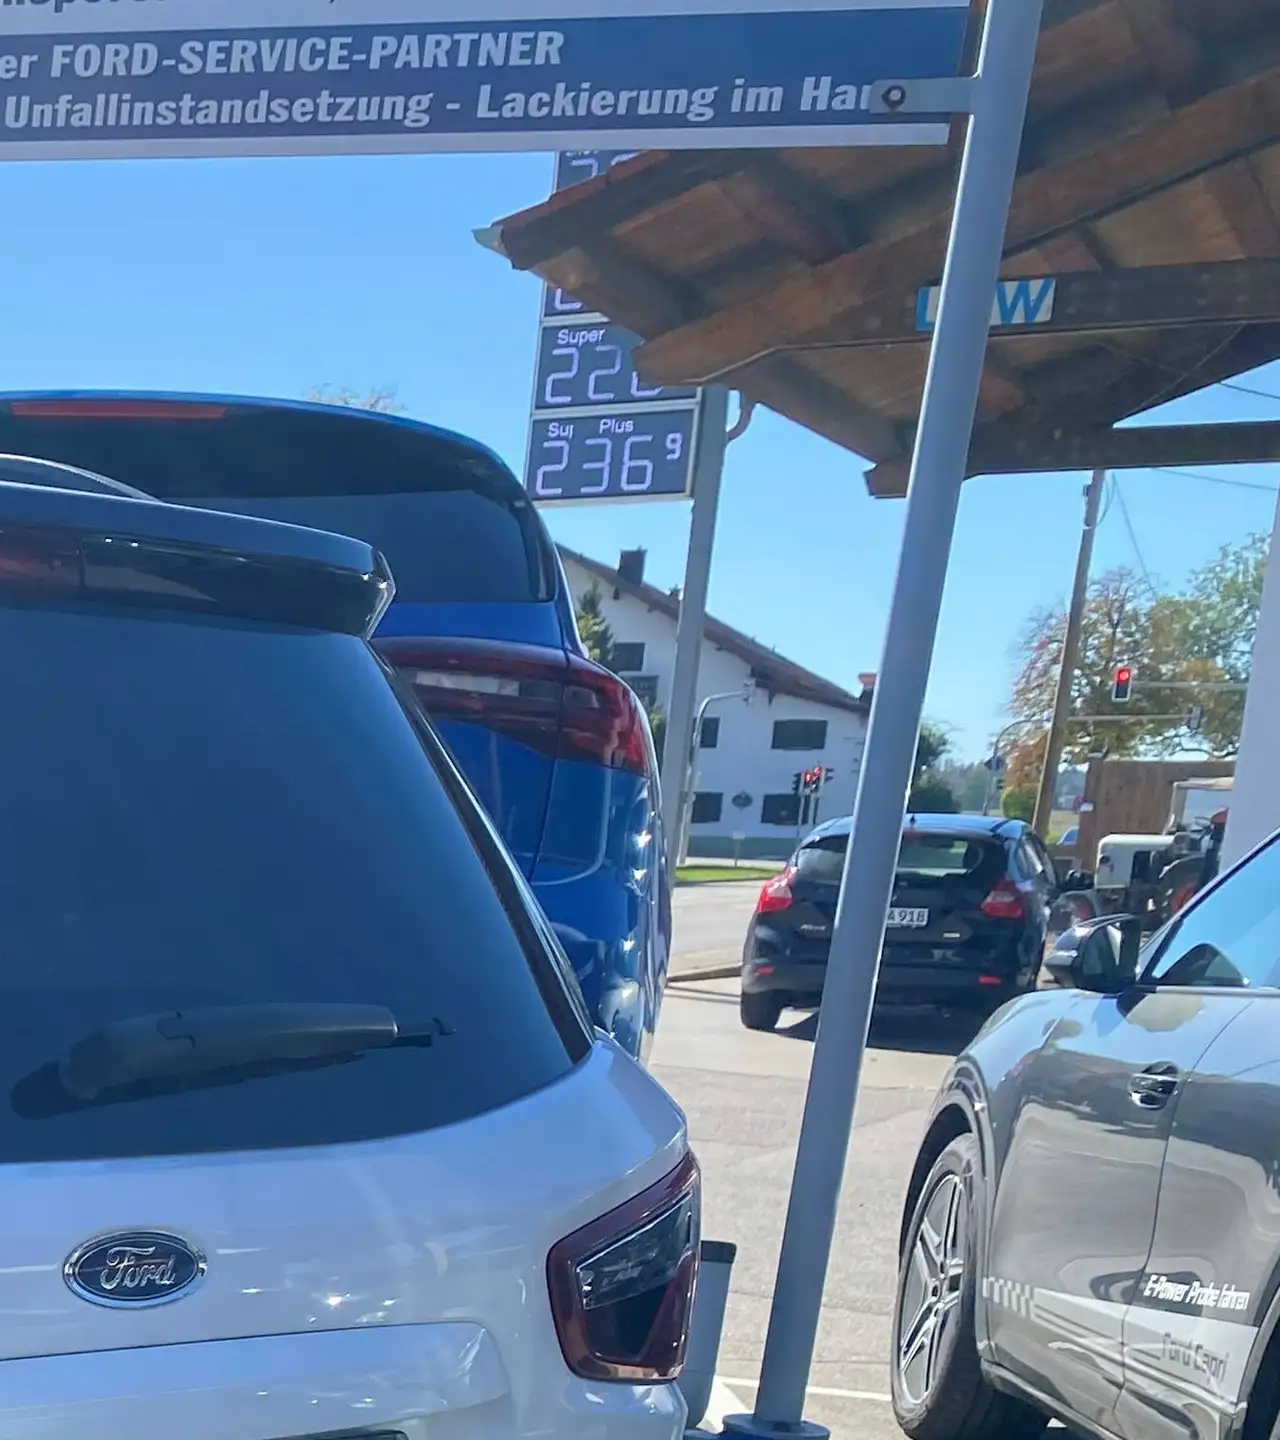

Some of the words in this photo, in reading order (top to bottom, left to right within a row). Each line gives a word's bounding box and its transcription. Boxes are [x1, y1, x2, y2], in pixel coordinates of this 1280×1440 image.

[50, 31, 565, 80] FORD-SERVICE-PARTNER
[4, 90, 433, 129] Unfallinstandsetzung
[476, 79, 719, 122] Lackierung
[731, 78, 783, 113] im
[557, 328, 606, 346] Super
[599, 418, 634, 434] Plus
